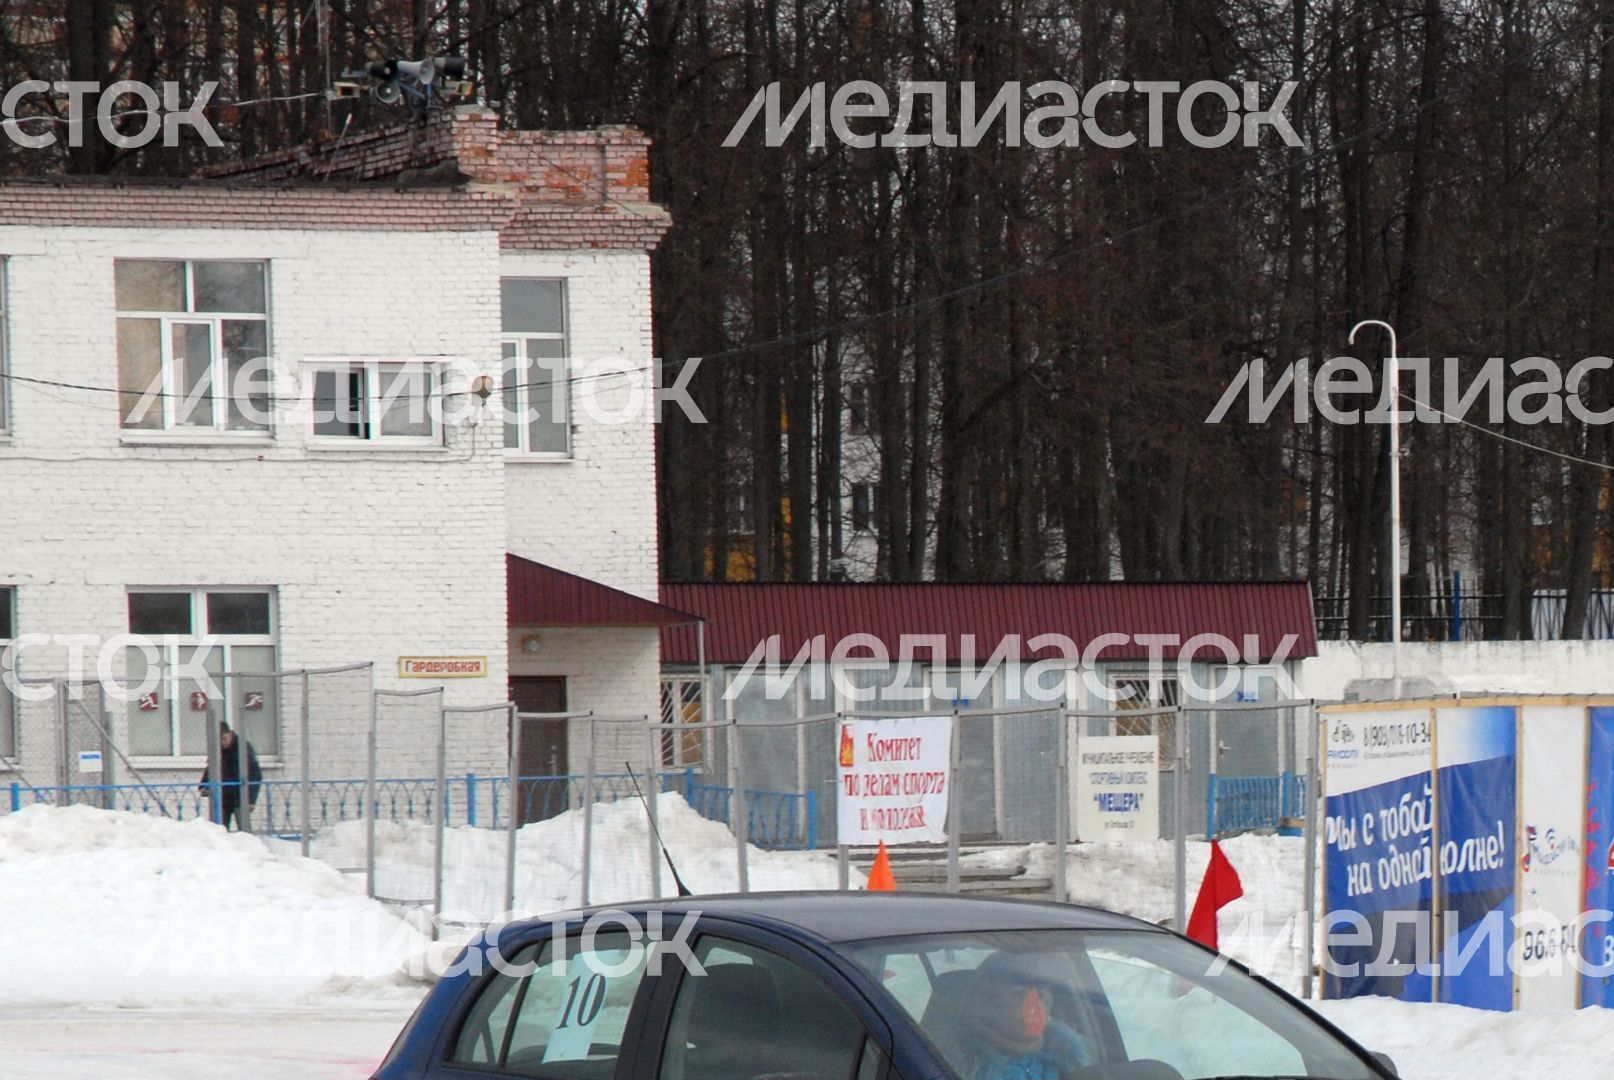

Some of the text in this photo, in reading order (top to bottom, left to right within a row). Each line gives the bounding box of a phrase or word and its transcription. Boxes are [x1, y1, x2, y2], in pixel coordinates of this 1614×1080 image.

[867, 732, 921, 762] Комитет
[844, 771, 945, 798] по делам спорта
[1362, 812, 1374, 846] с
[1346, 861, 1373, 897] на
[555, 973, 607, 1030] 10
